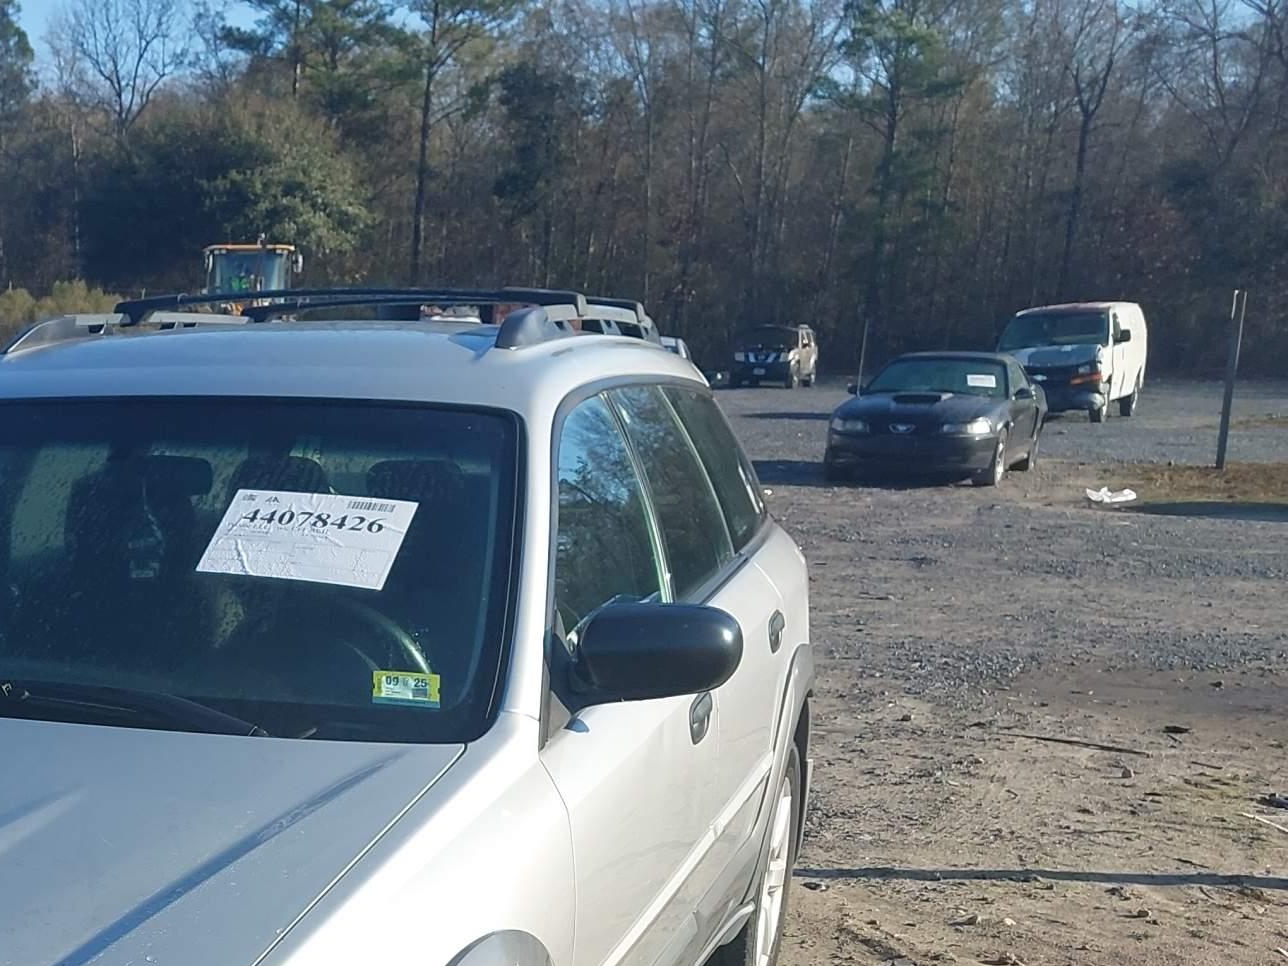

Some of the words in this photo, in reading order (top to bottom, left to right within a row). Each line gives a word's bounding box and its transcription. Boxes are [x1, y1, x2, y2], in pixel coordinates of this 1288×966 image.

[242, 508, 388, 534] 44078426
[386, 676, 399, 686] 09
[414, 678, 427, 687] 25
